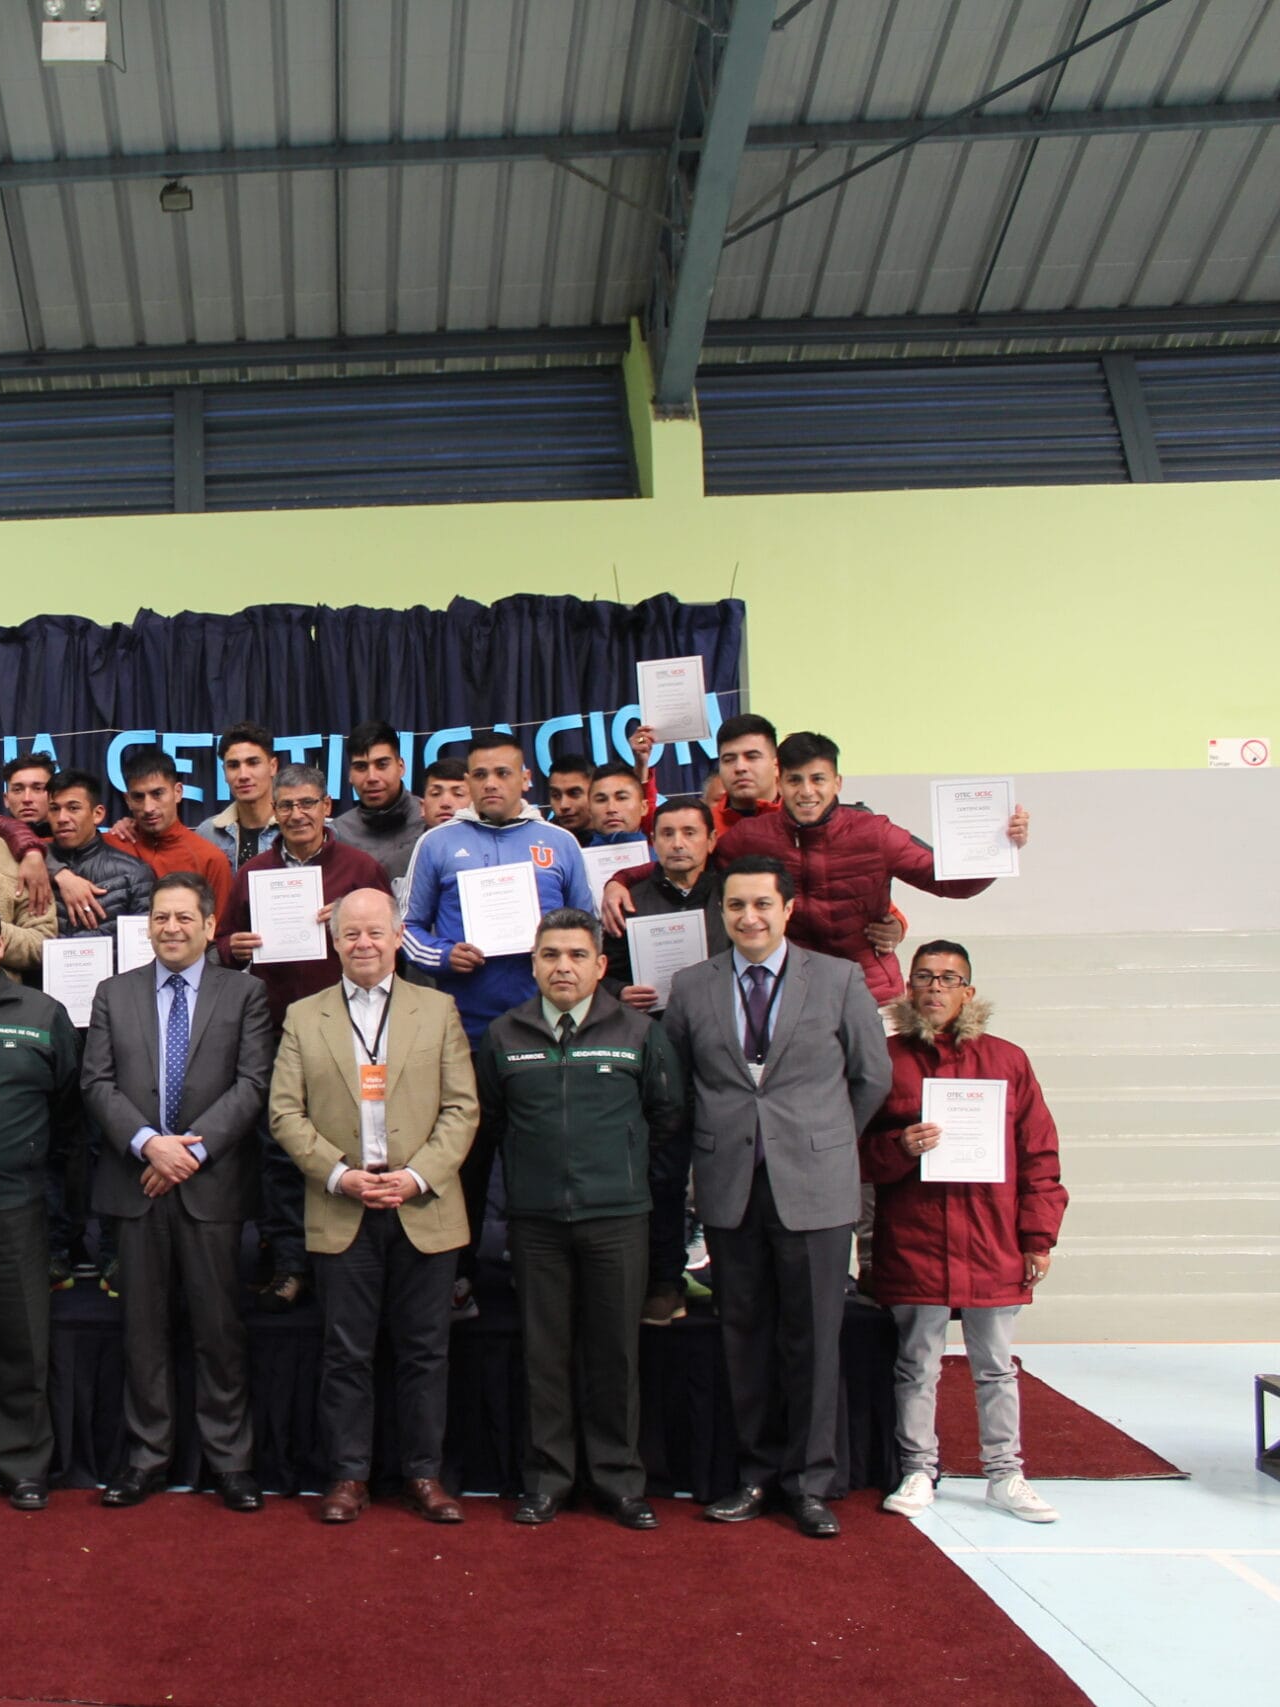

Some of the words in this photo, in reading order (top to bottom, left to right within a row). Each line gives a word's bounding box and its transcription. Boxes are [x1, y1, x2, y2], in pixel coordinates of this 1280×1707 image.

[25, 1030, 40, 1038] CHILE
[572, 1050, 611, 1058] GENDARMERIA
[621, 1051, 636, 1060] CHILE
